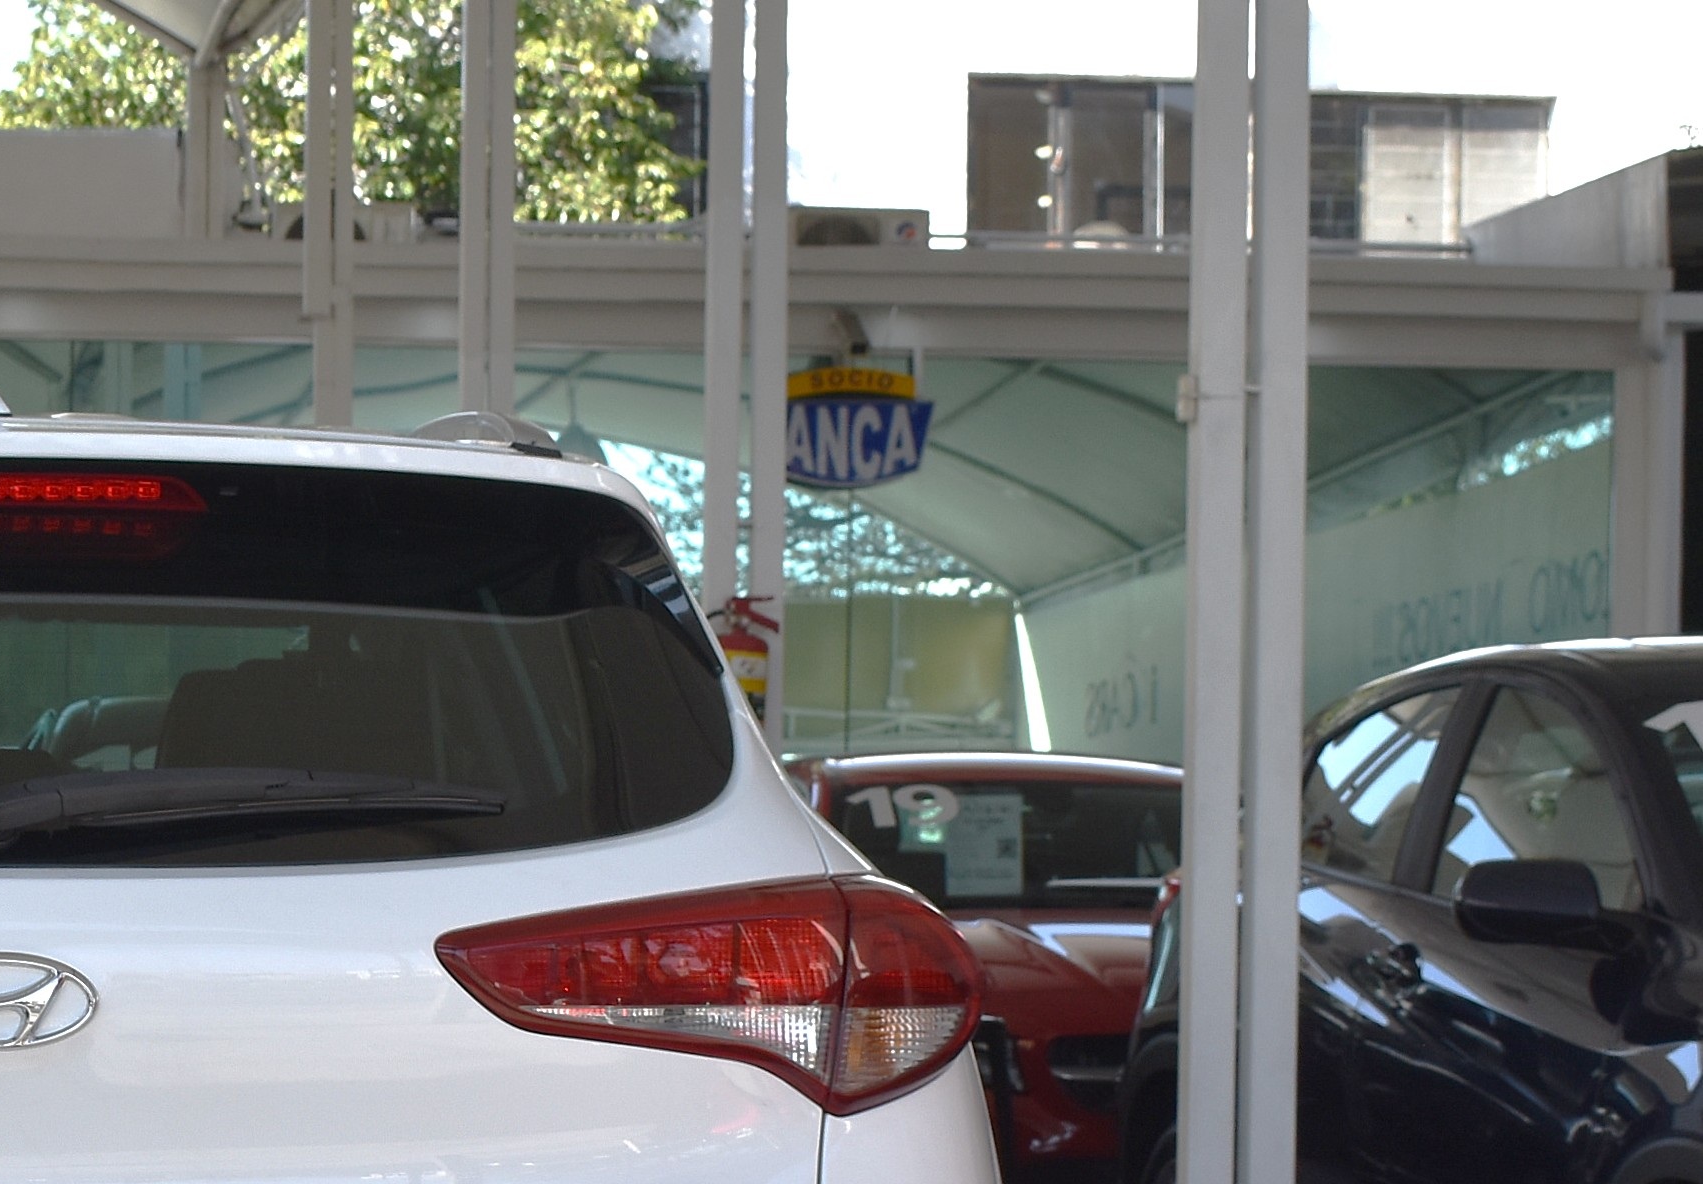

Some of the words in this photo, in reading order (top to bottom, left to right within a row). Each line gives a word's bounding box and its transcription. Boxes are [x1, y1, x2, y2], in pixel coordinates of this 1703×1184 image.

[810, 369, 894, 389] SOCIO
[787, 403, 919, 481] ANCA
[847, 783, 959, 829] 19
